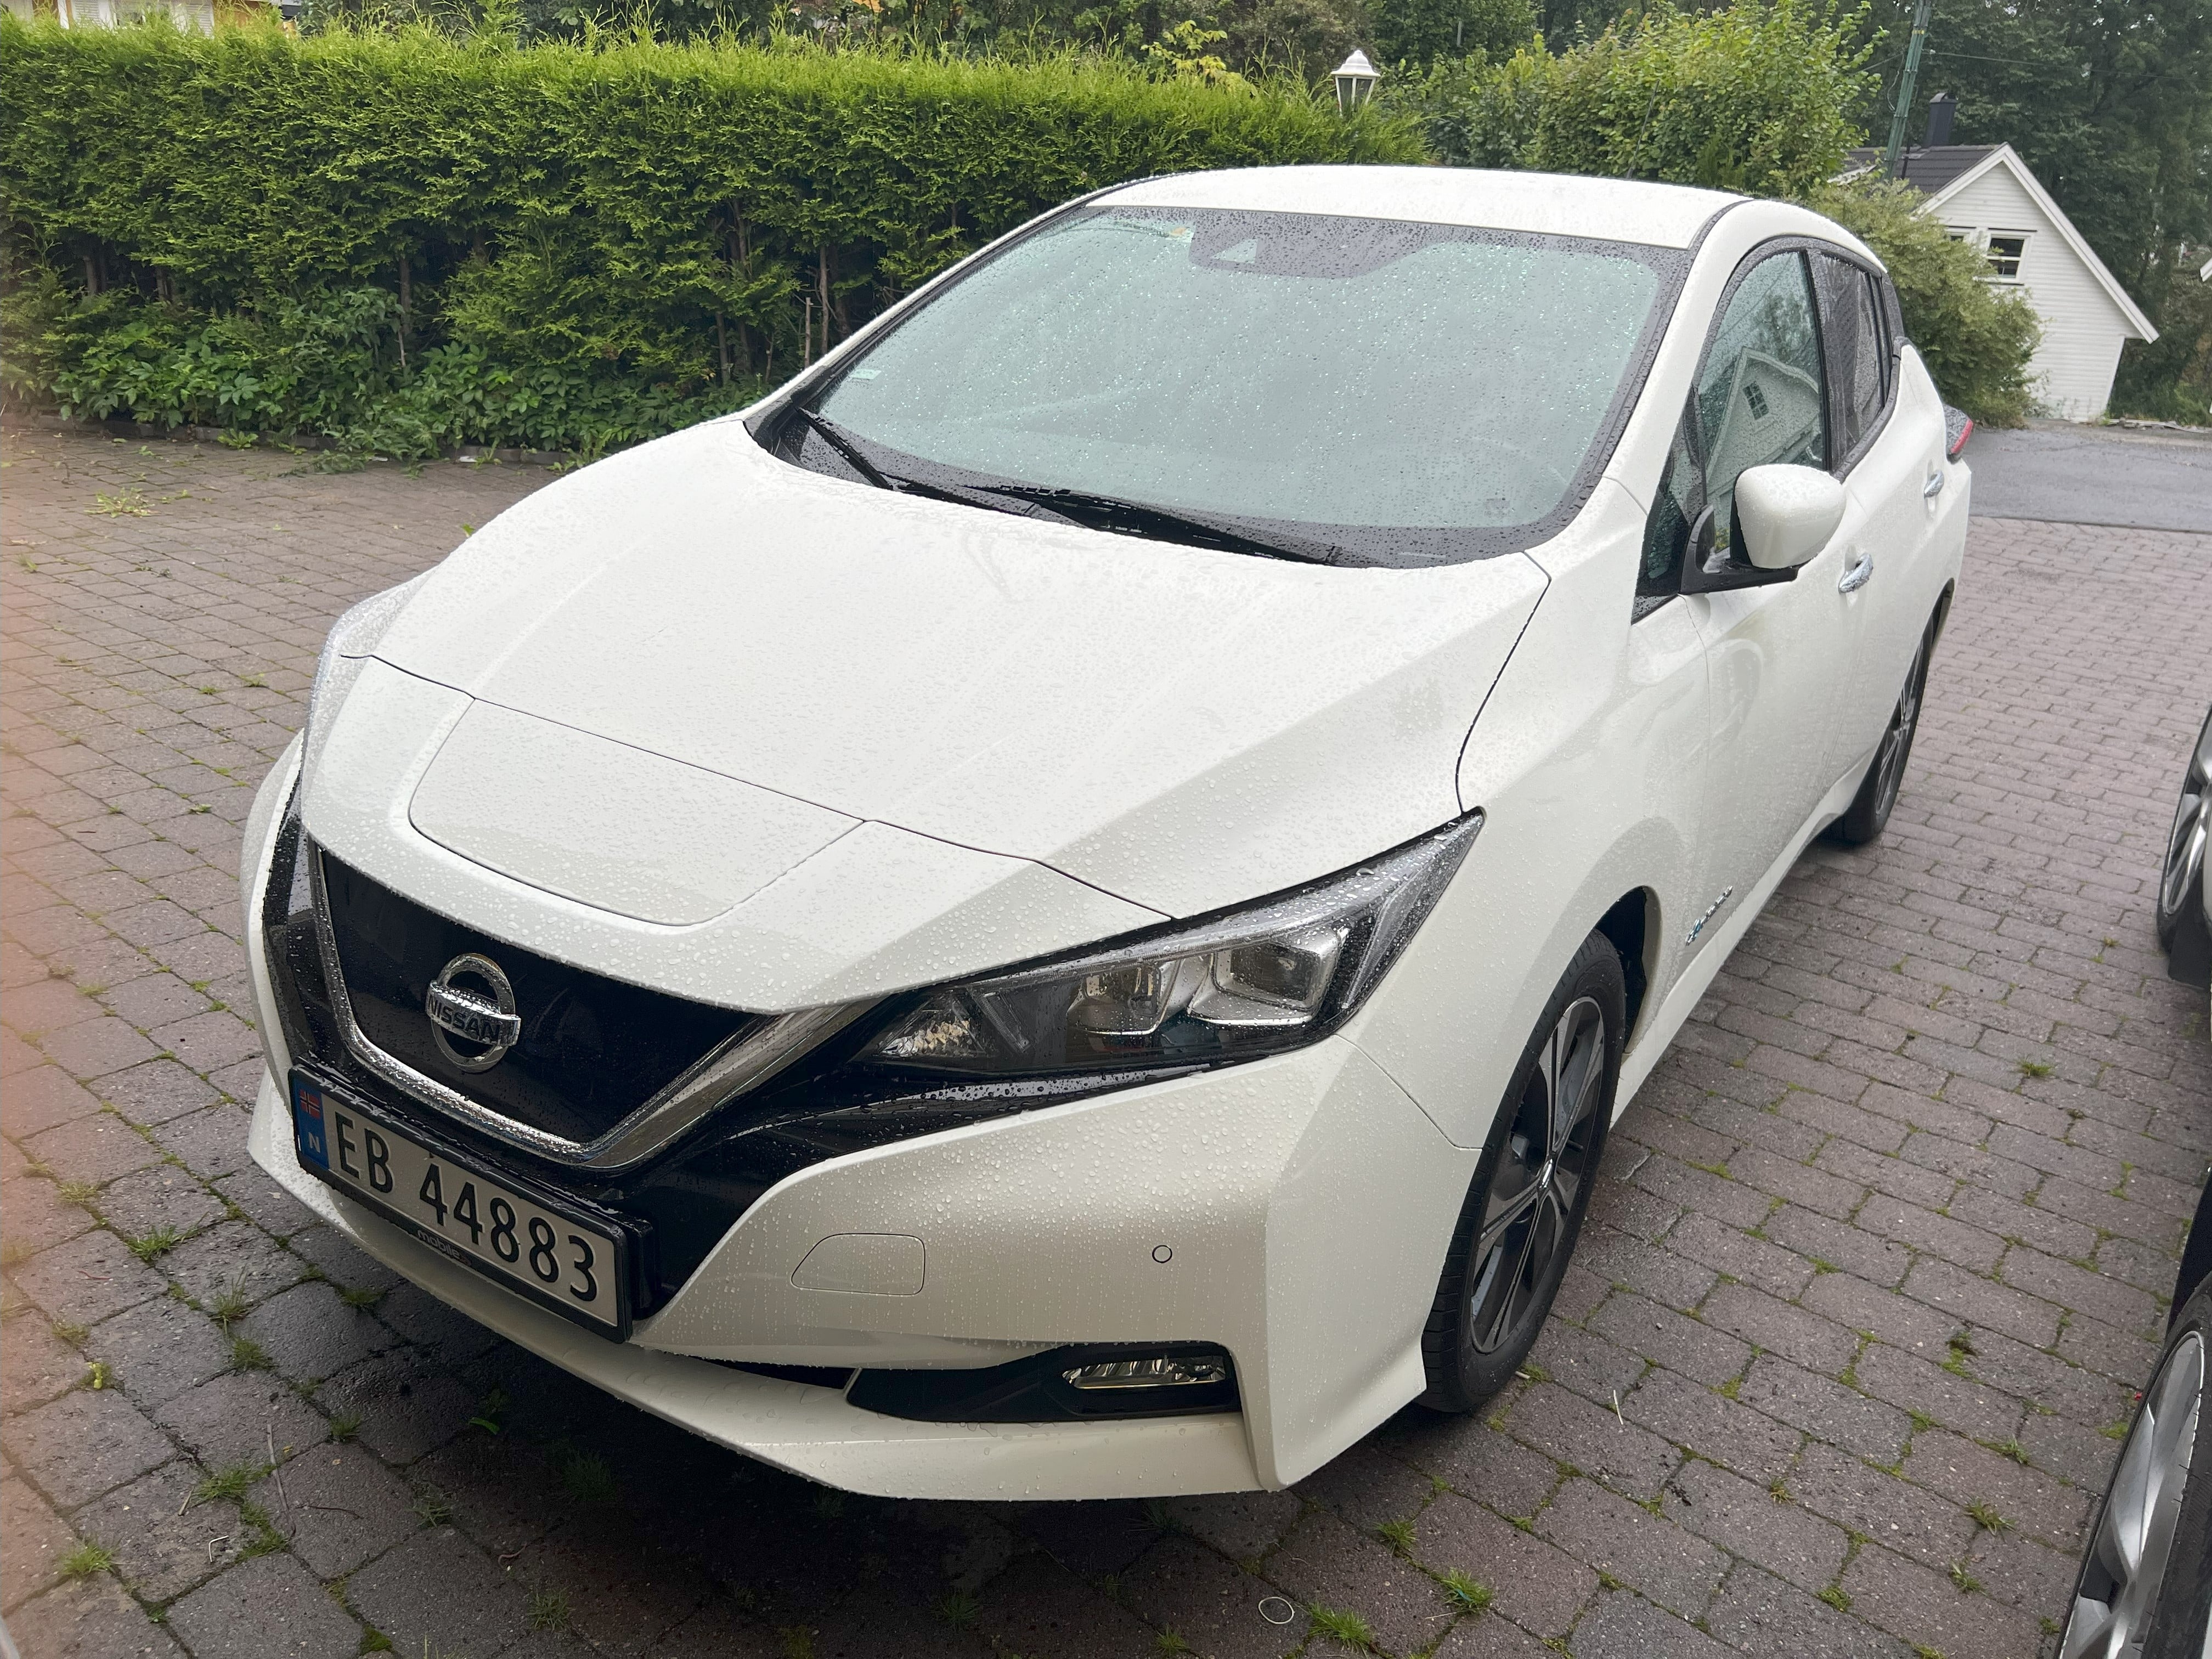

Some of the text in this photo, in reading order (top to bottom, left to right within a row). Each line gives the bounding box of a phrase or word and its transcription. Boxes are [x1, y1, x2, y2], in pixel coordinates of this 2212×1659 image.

[426, 996, 501, 1043] NISSAN
[308, 1131, 321, 1153] N
[335, 1111, 597, 1302] EB 44883
[417, 1229, 461, 1260] mobile
